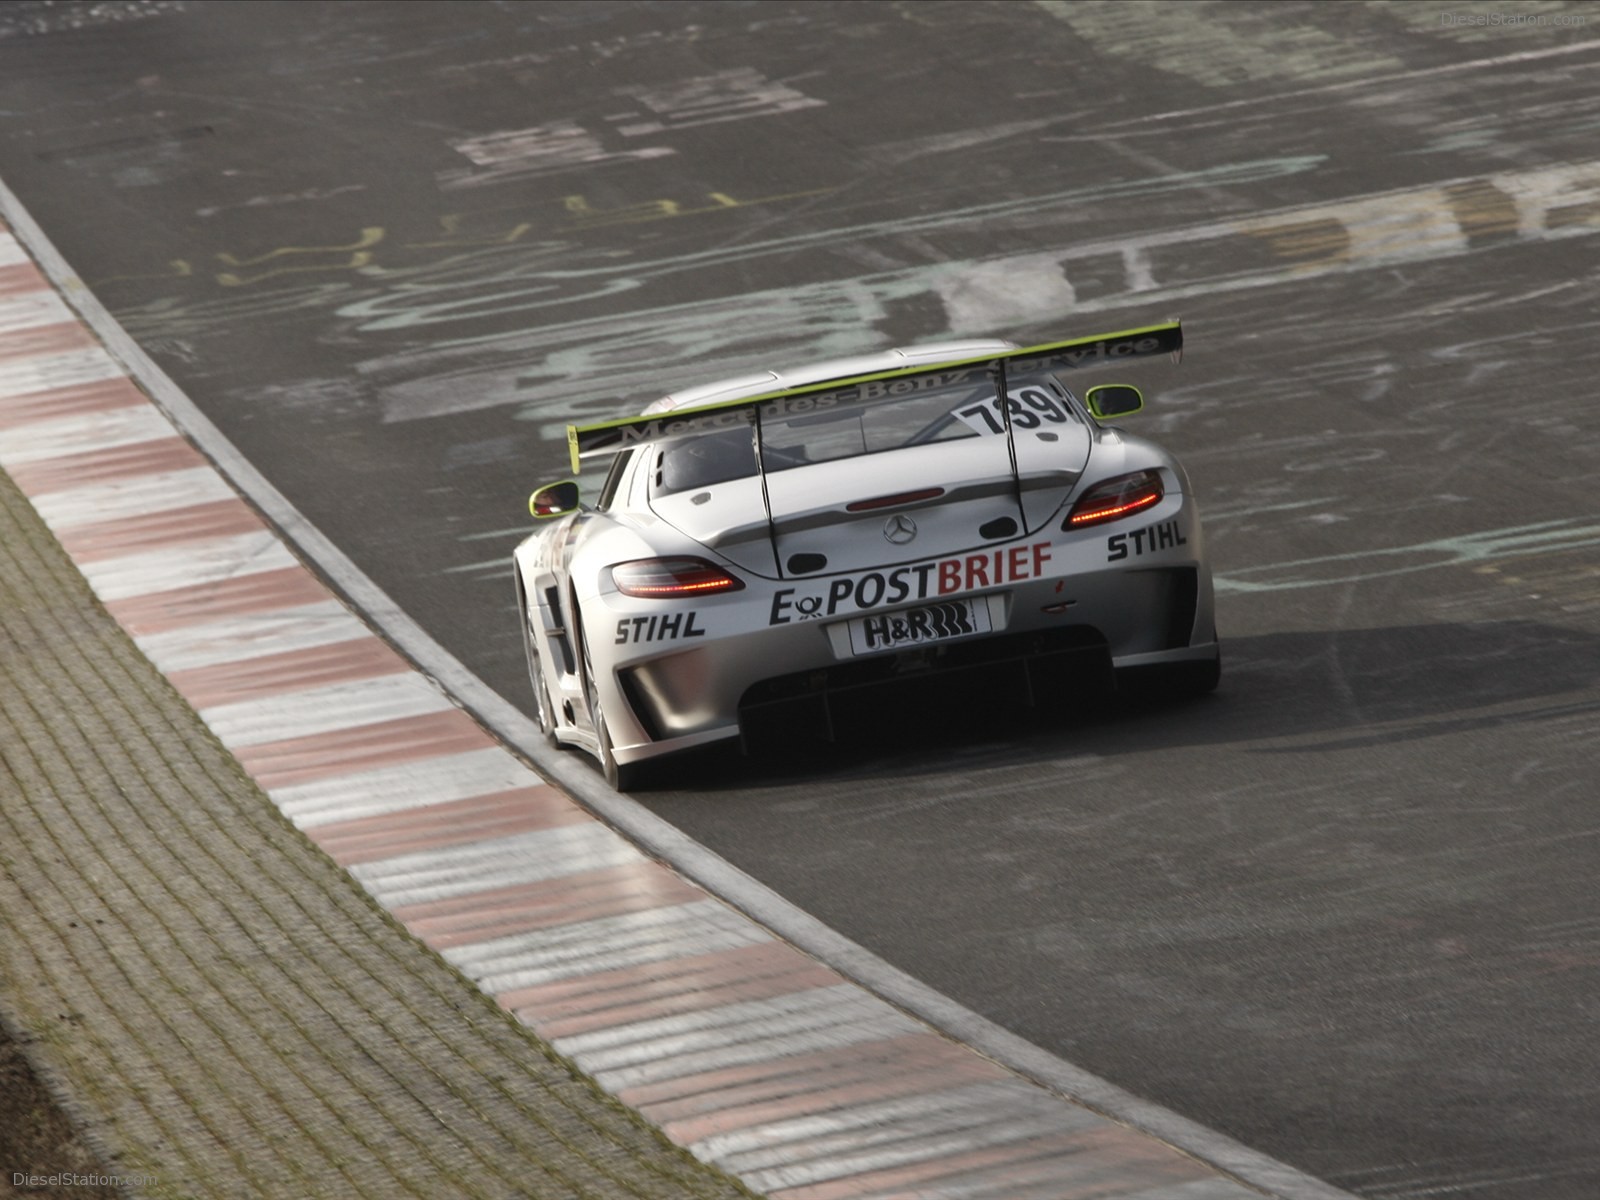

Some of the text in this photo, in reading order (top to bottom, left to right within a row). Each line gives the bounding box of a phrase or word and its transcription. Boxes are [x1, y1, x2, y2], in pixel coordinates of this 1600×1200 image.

[960, 390, 1067, 434] 739
[1108, 521, 1187, 562] STIHL
[615, 611, 706, 645] STIHL
